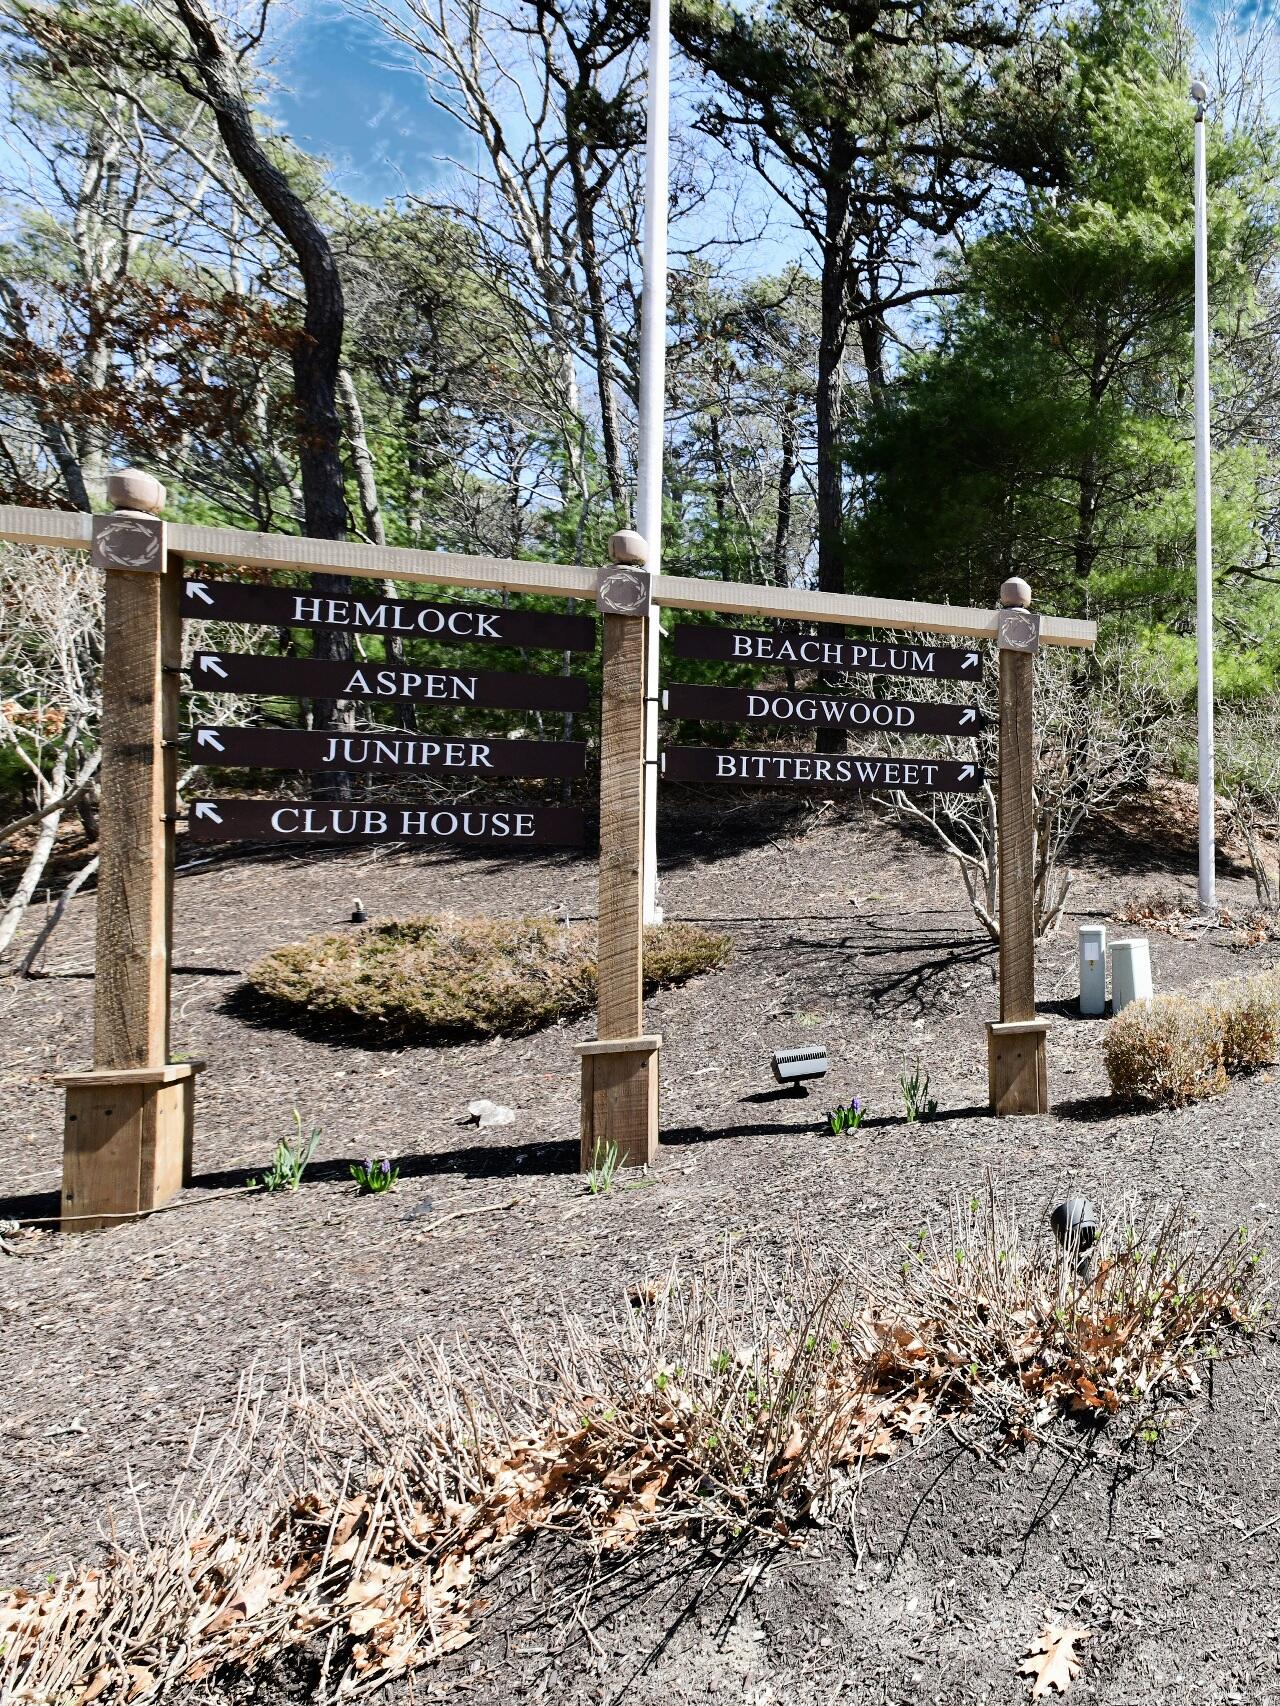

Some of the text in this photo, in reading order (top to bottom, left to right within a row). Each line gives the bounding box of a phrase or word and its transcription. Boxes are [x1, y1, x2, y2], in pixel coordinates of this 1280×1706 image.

[292, 597, 502, 638] HEMLOCK
[732, 635, 935, 672] BEACH PLUM
[343, 670, 478, 700] ASPEN
[747, 695, 915, 726] DOGWOOD
[322, 738, 494, 768] JUNIPER
[716, 756, 939, 785] BITTERSWEET
[271, 808, 535, 837] CLUB HOUSE
